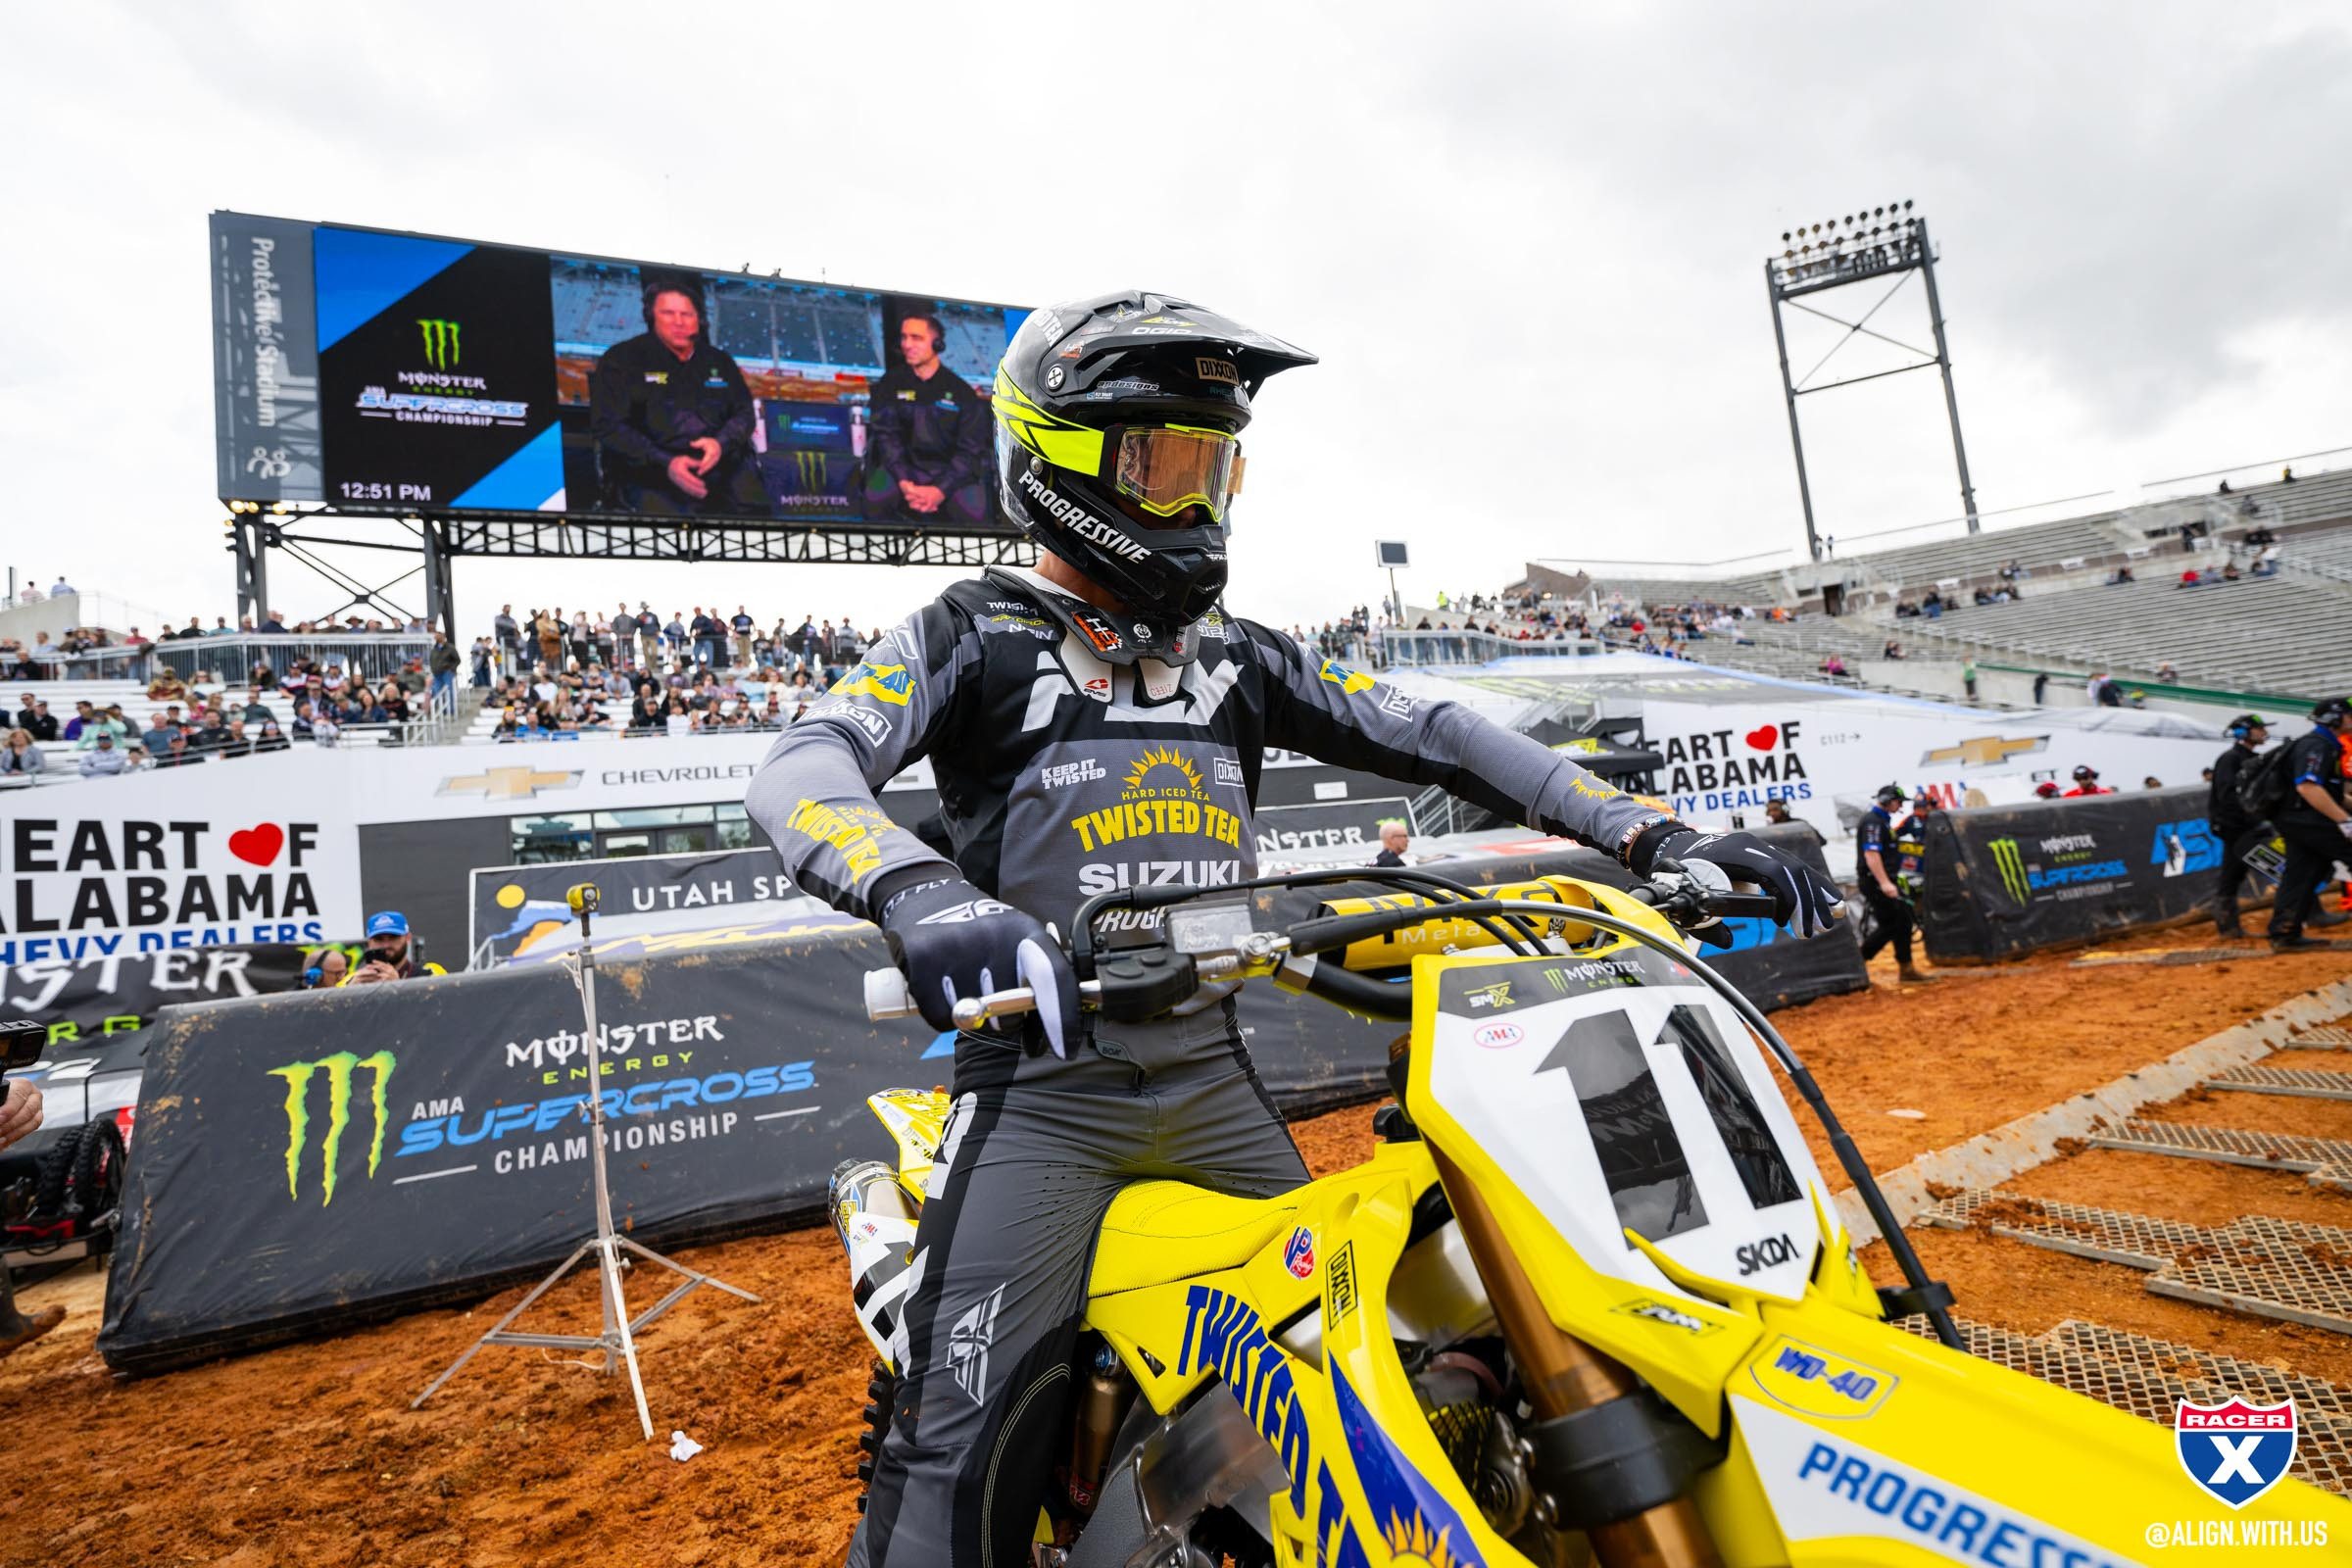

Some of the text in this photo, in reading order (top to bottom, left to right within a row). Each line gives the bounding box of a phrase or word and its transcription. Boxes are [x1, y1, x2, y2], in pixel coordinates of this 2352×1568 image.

[1132, 326, 1193, 335] OGIO
[255, 344, 279, 427] Stadium
[398, 371, 487, 390] MONSTER
[1200, 359, 1238, 383] DIXXON
[395, 412, 493, 426] CHAMPIONSHIP
[340, 482, 431, 501] 12:51 PM
[1018, 469, 1152, 564] PROGRESSIVE
[602, 763, 758, 785] CHEVROLET
[1041, 759, 1097, 779] KEEP IT
[1042, 767, 1106, 790] TWISTED
[1121, 788, 1210, 802] HARD ICED TEA
[1071, 800, 1240, 853] TWISTED TEA
[1255, 826, 1368, 853] NSTER
[0, 818, 210, 873] EART
[915, 878, 950, 894] FLY
[1078, 859, 1241, 896] SUZUKI
[632, 879, 734, 911] UTAH
[1401, 921, 1510, 945] Metas
[0, 949, 259, 1012] STER
[1564, 960, 1645, 981] MONSTER
[506, 1015, 724, 1068] MONSTER
[543, 1052, 694, 1085] ENERGY
[394, 1060, 815, 1156] SUPERCROSS
[411, 1096, 466, 1122] AMA
[1534, 1004, 1803, 1251] 11
[1330, 1250, 1352, 1318] DIXXON
[1773, 1345, 1878, 1401] WD-40
[1176, 1285, 1310, 1520] TWISTED
